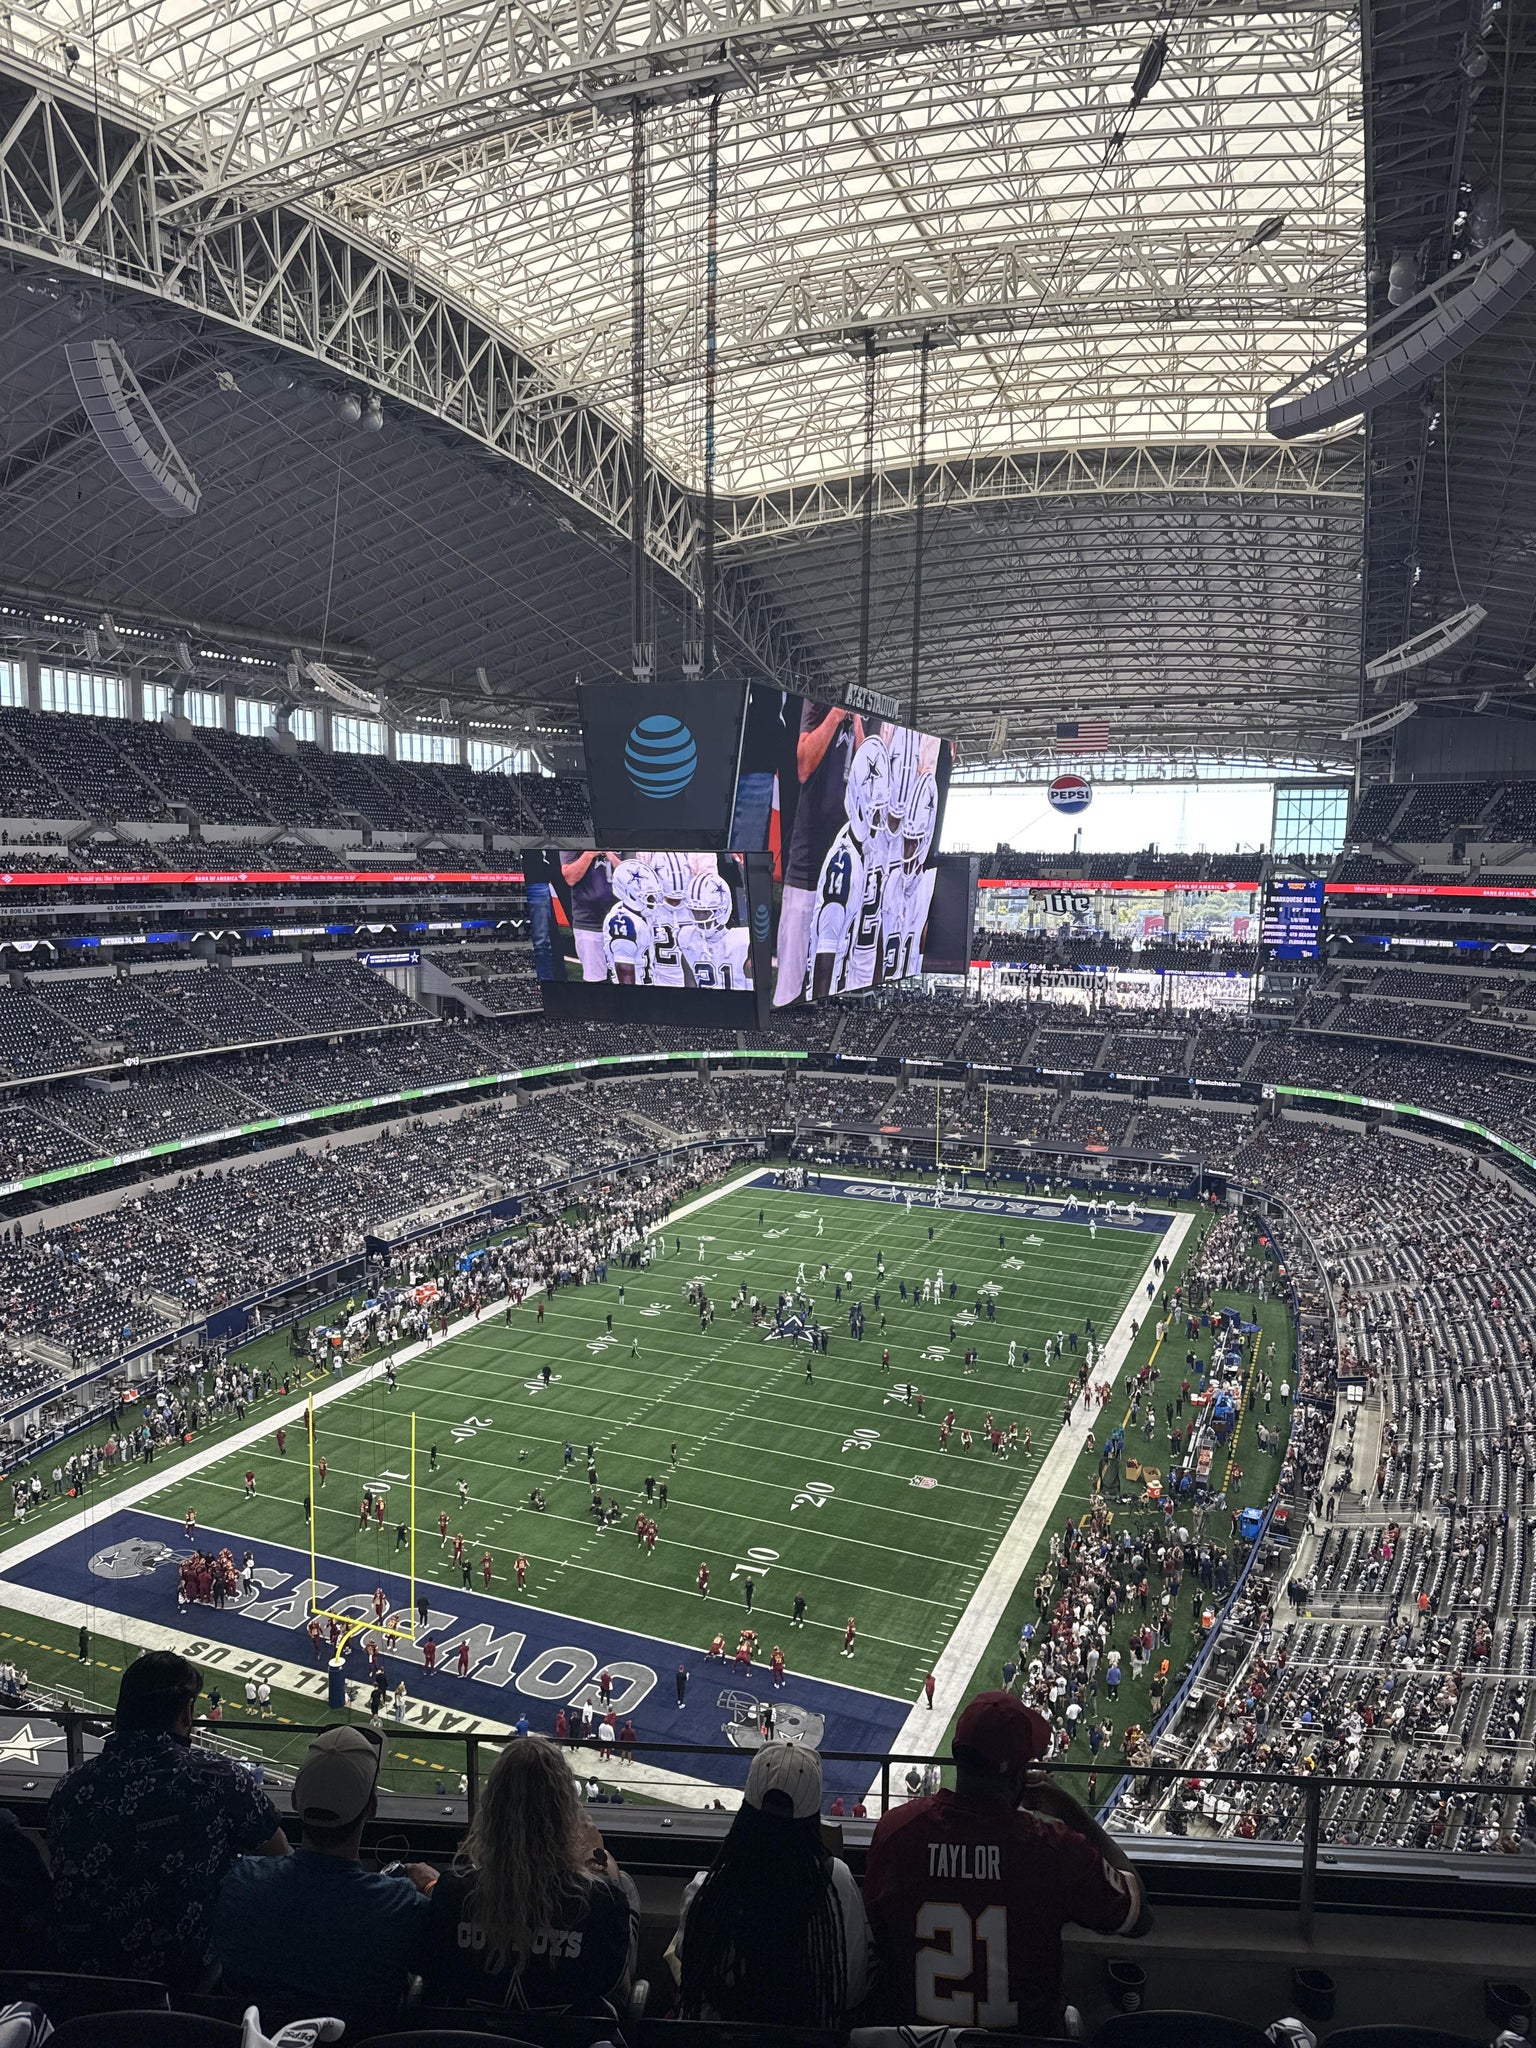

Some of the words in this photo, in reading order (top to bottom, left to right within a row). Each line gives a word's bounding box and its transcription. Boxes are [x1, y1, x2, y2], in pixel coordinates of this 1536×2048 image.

[844, 683, 868, 709] AT&T
[866, 690, 900, 719] STADIUM
[1051, 790, 1089, 800] PEPSI
[828, 872, 844, 895] 14
[614, 924, 627, 936] 14
[1000, 973, 1037, 986] AT&T
[1040, 974, 1108, 989] STADIUM
[841, 1054, 878, 1062] Blockchain.com
[972, 1063, 1012, 1071] Blockchain.com
[1043, 1068, 1084, 1076] Blockchain.com
[1116, 1073, 1160, 1082] Blockchain.com
[1196, 1079, 1241, 1088] Blockchain.com
[1262, 1088, 1275, 1098] 25
[122, 1153, 139, 1163] Globe
[140, 1150, 152, 1161] Life
[9, 1182, 23, 1193] Life
[844, 1184, 1065, 1217] COWBOYS
[977, 1284, 1003, 1296] 30
[640, 1302, 672, 1316] 50
[586, 1335, 618, 1351] 40
[928, 1346, 950, 1362] 50
[450, 1416, 493, 1437] 20
[844, 1428, 880, 1450] 30
[362, 1470, 410, 1493] 10
[794, 1482, 835, 1508] 20
[735, 1547, 780, 1577] 10
[200, 1567, 658, 1715] COWBOYS
[182, 1640, 232, 1664] US
[234, 1658, 283, 1680] OF
[928, 1842, 1001, 1880] TAYLOR
[458, 1921, 583, 1959] COOYS
[915, 1901, 1019, 2028] 21
[282, 2030, 314, 2042] PEPSI
